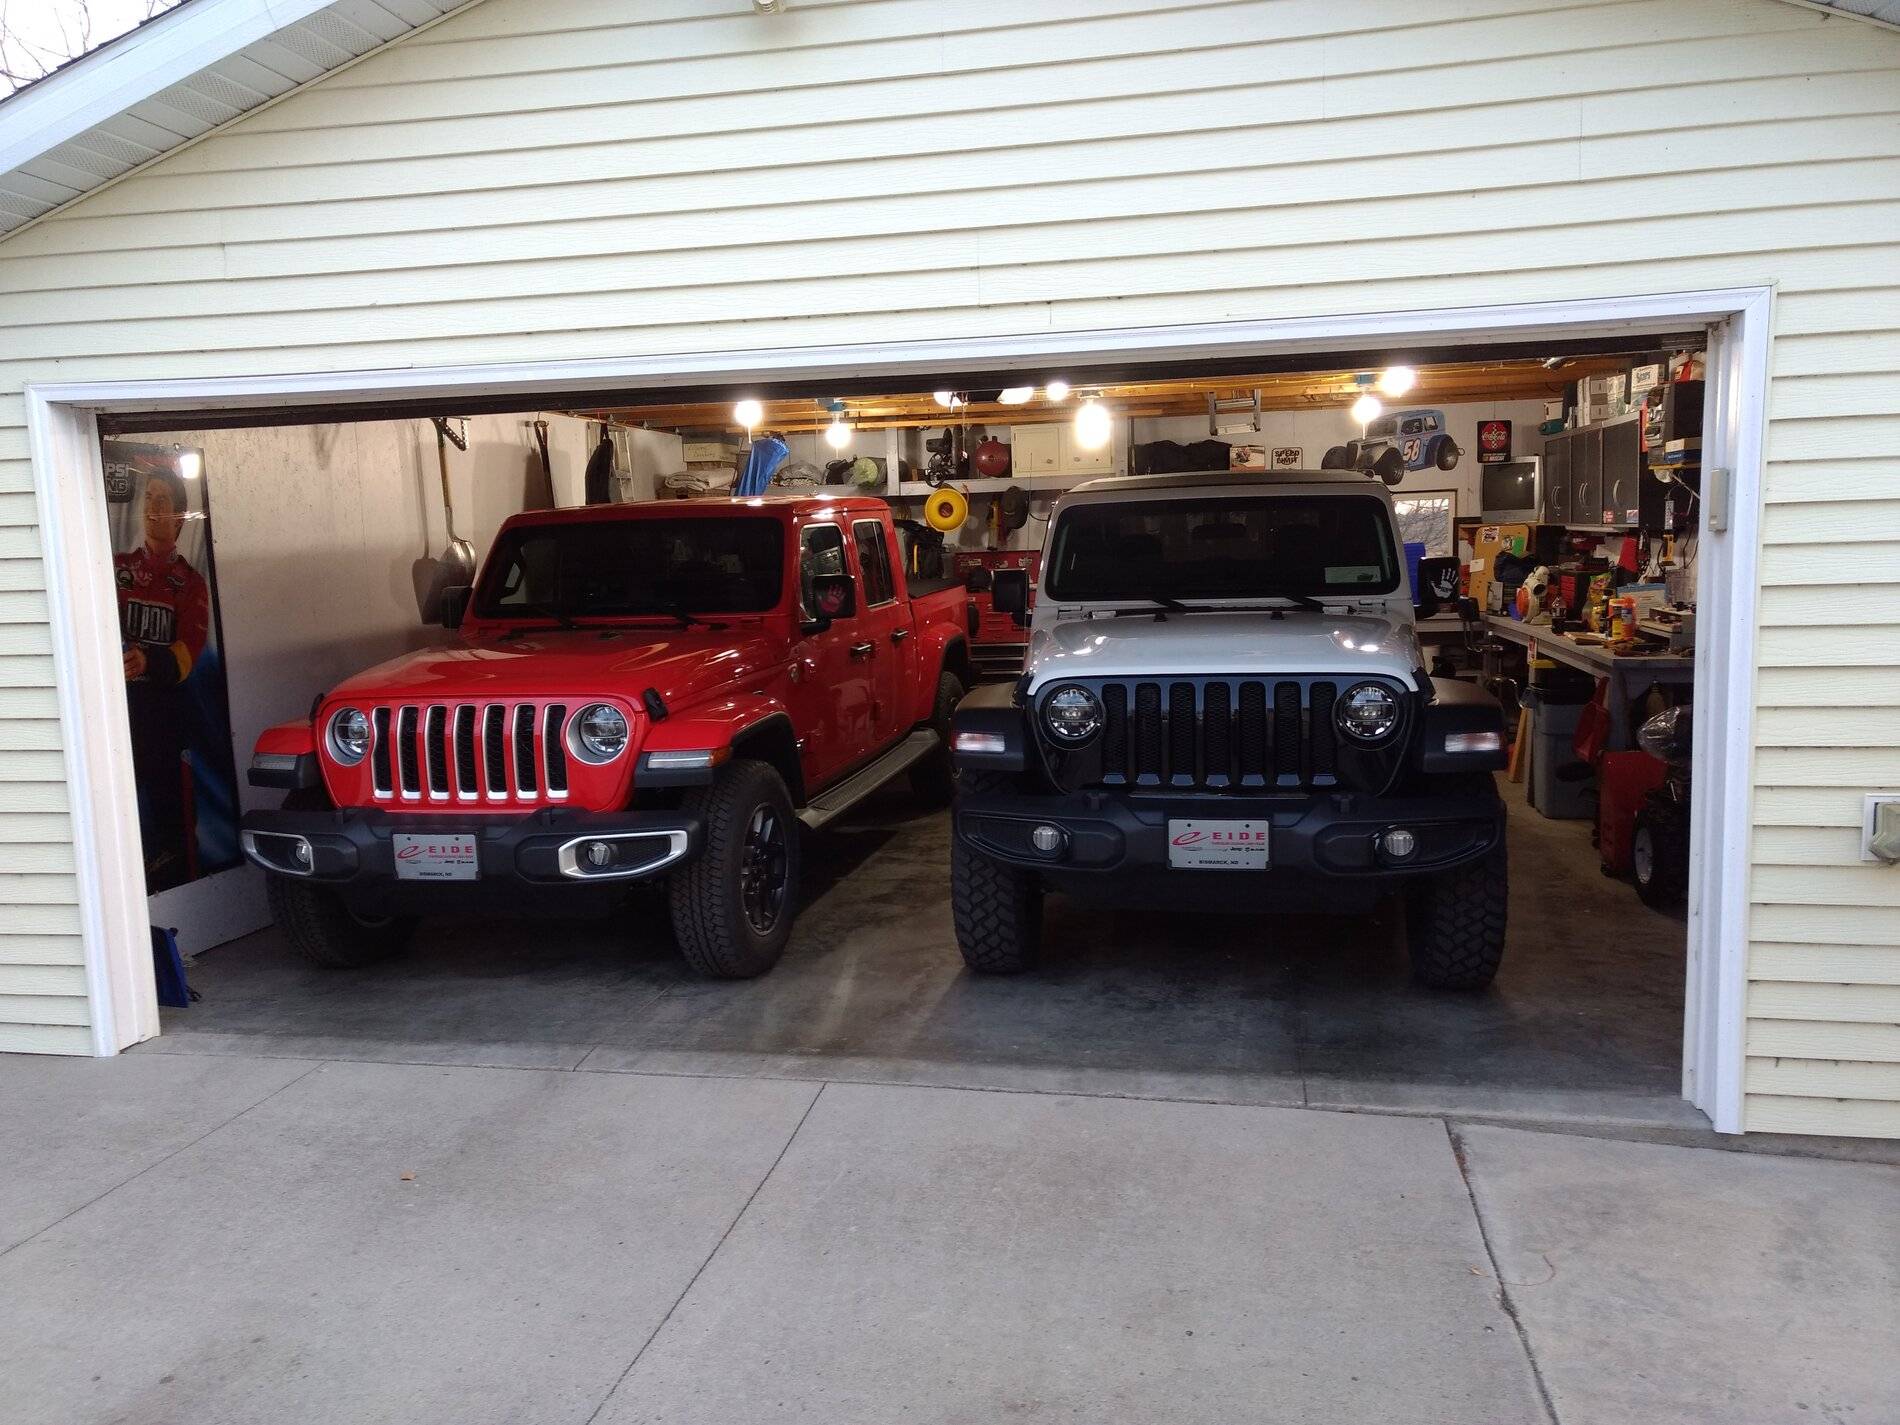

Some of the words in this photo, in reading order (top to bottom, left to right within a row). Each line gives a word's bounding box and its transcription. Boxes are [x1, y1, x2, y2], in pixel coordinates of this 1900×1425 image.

[1403, 439, 1420, 462] 58
[104, 463, 130, 477] PSI
[1212, 832, 1265, 840] EIDE
[428, 845, 474, 853] EIDE
